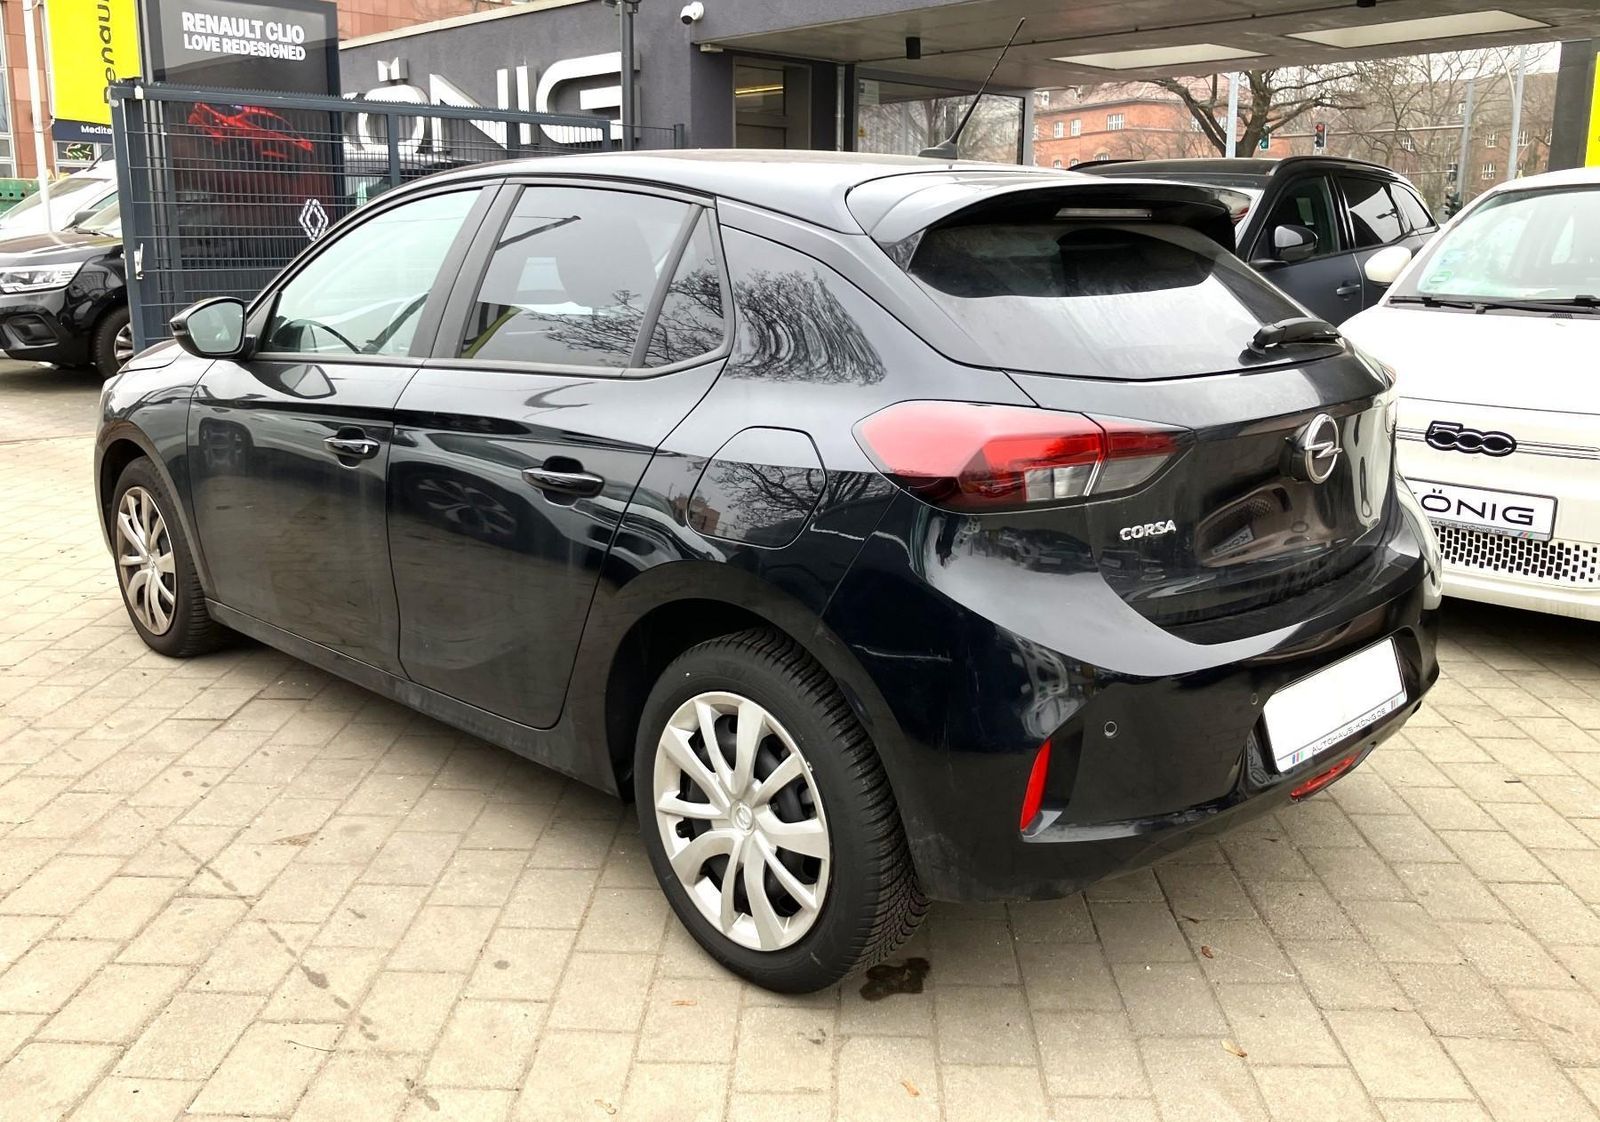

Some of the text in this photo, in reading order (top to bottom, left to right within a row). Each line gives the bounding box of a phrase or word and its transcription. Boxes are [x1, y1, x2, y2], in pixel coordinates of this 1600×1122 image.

[182, 11, 305, 44] RENAULT CLIO
[97, 0, 117, 104] enau
[184, 33, 306, 61] LOVE REDESIGNED
[1425, 420, 1517, 457] 500
[1413, 488, 1535, 526] ÖNIG
[1119, 519, 1177, 541] CORSA
